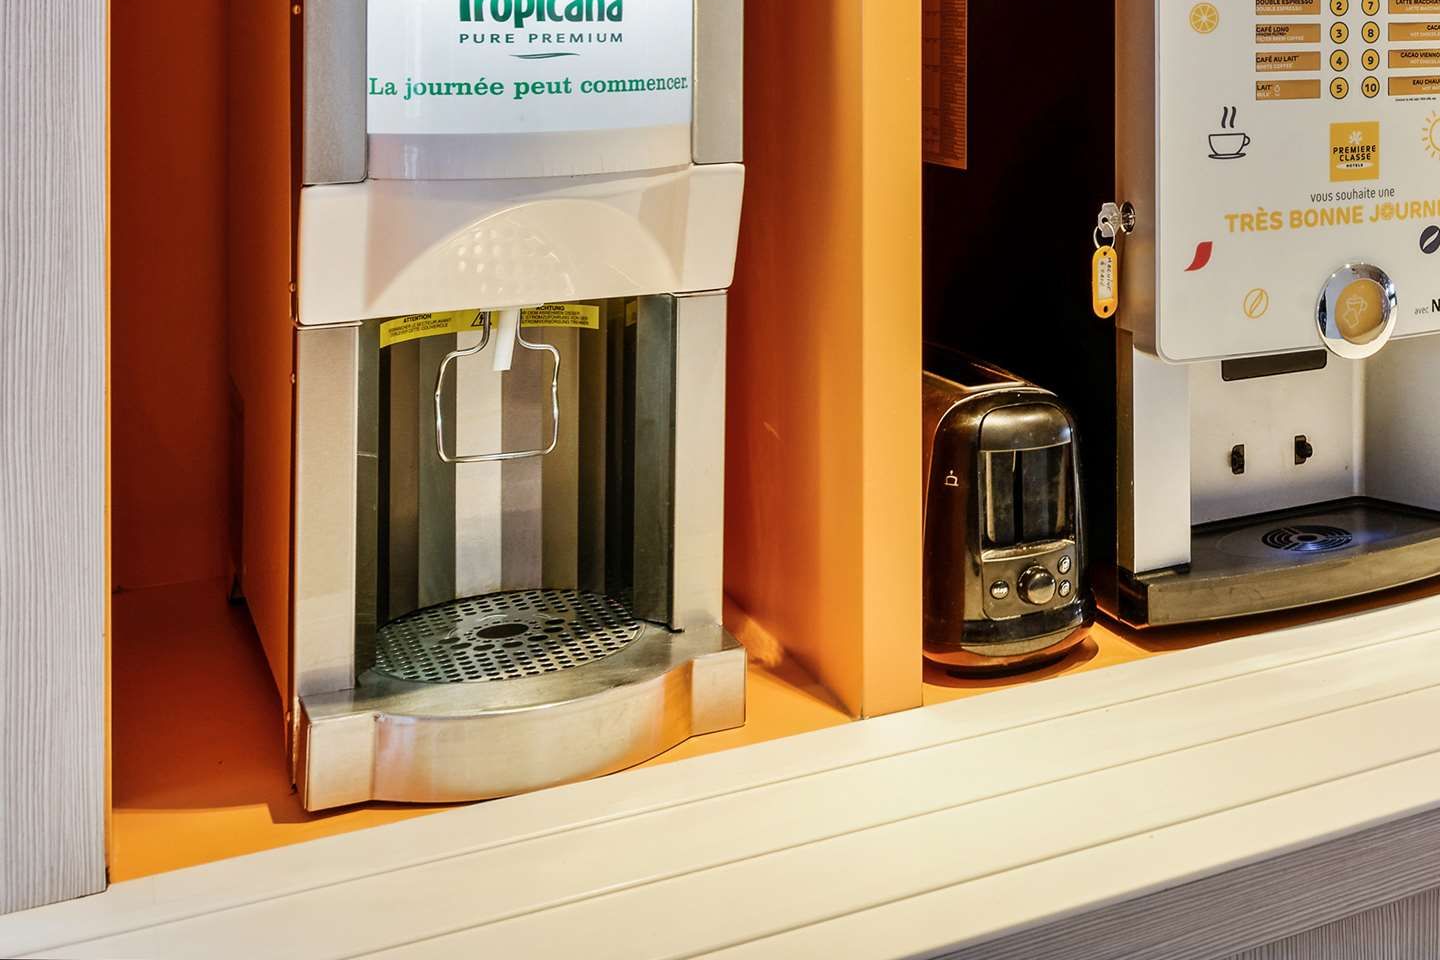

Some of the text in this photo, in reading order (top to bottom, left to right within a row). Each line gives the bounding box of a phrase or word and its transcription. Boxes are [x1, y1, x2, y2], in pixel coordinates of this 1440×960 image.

[1336, 1, 1342, 10] 2
[1368, 1, 1374, 10] 7
[459, 32, 623, 43] PURE PREMIUM
[1336, 29, 1342, 38] 3
[1368, 29, 1374, 37] 8
[1336, 57, 1342, 65] 4
[1368, 56, 1374, 64] 9
[368, 78, 398, 96] La
[403, 77, 505, 101] journée
[513, 78, 573, 100] peut
[1336, 85, 1342, 93] 5
[1365, 83, 1377, 92] 10
[1332, 145, 1376, 154] PREMIERE
[1339, 153, 1371, 161] CLASSE
[1310, 187, 1395, 203] vous souhaite une
[1224, 207, 1283, 233] TRÈS
[1289, 206, 1363, 229] BONNE
[1414, 304, 1429, 315] avec
[403, 313, 432, 323] ATTENTION
